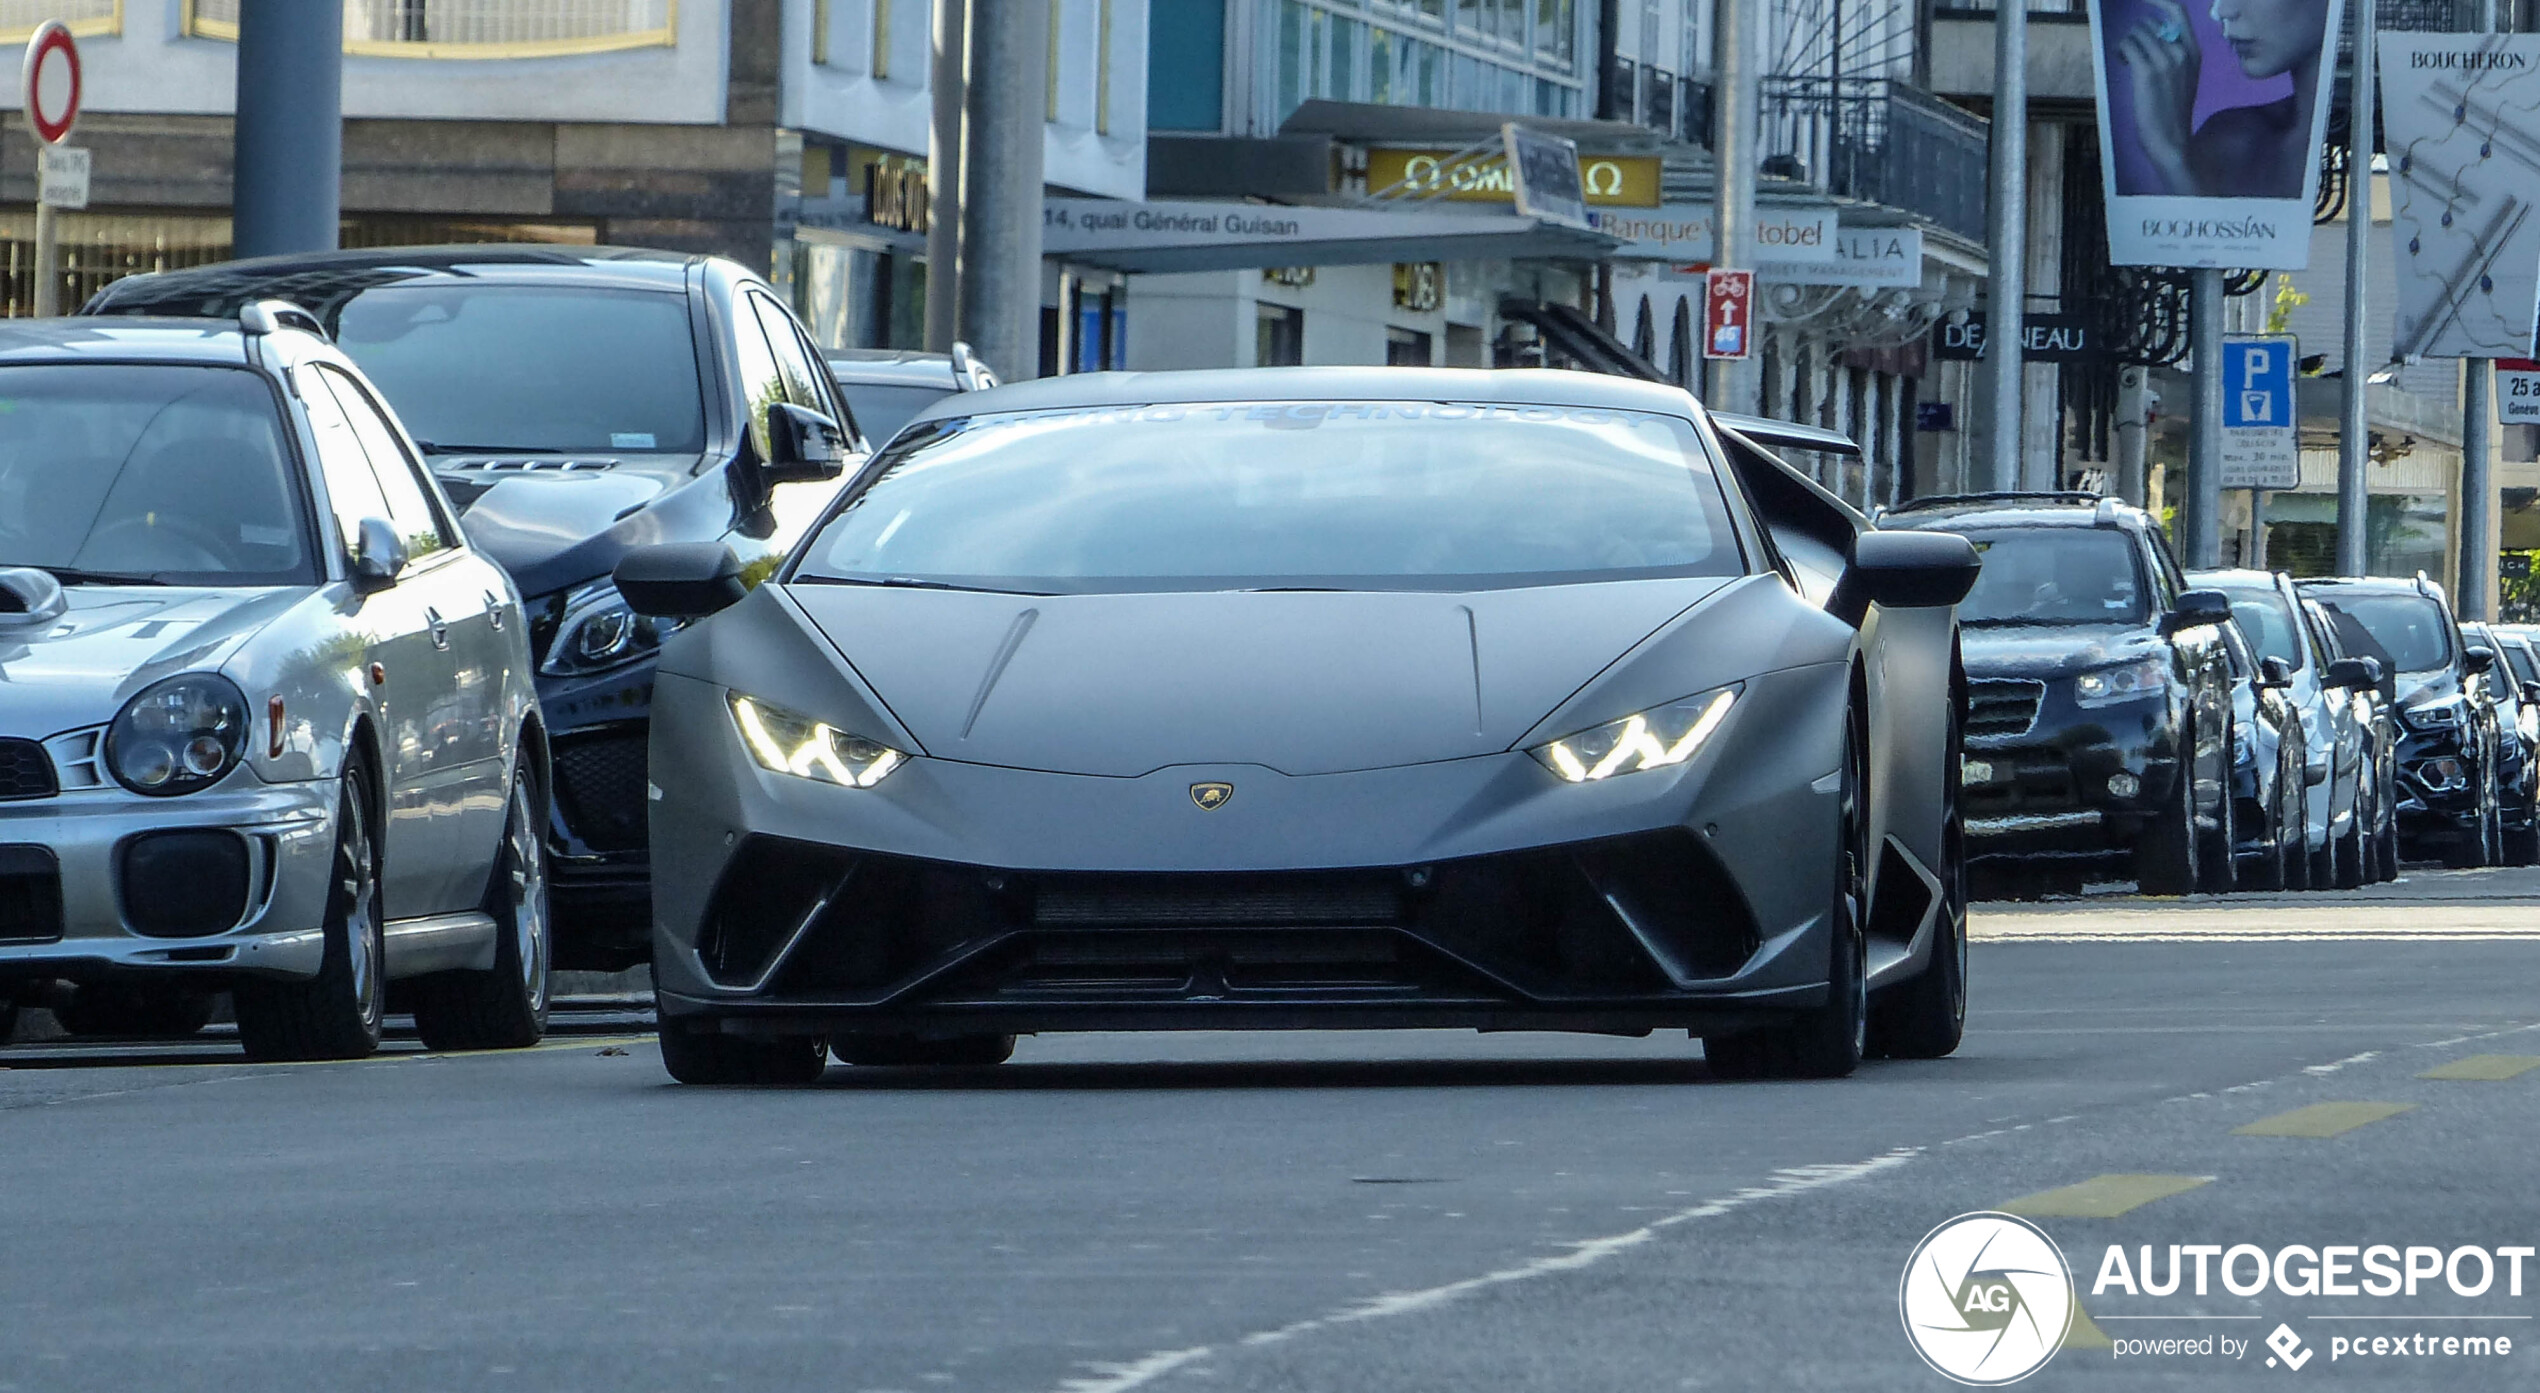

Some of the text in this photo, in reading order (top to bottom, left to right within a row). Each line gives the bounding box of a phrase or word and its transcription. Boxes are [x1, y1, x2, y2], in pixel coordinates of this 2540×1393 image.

[2411, 51, 2526, 69] BOUCHERON
[1044, 208, 1299, 236] 14, quai Général Guisan
[1600, 212, 1700, 247] Banque
[2142, 215, 2275, 239] BOGHOSSIAN
[2511, 377, 2529, 396] 25
[1205, 401, 1656, 429] TECHNOLOGY
